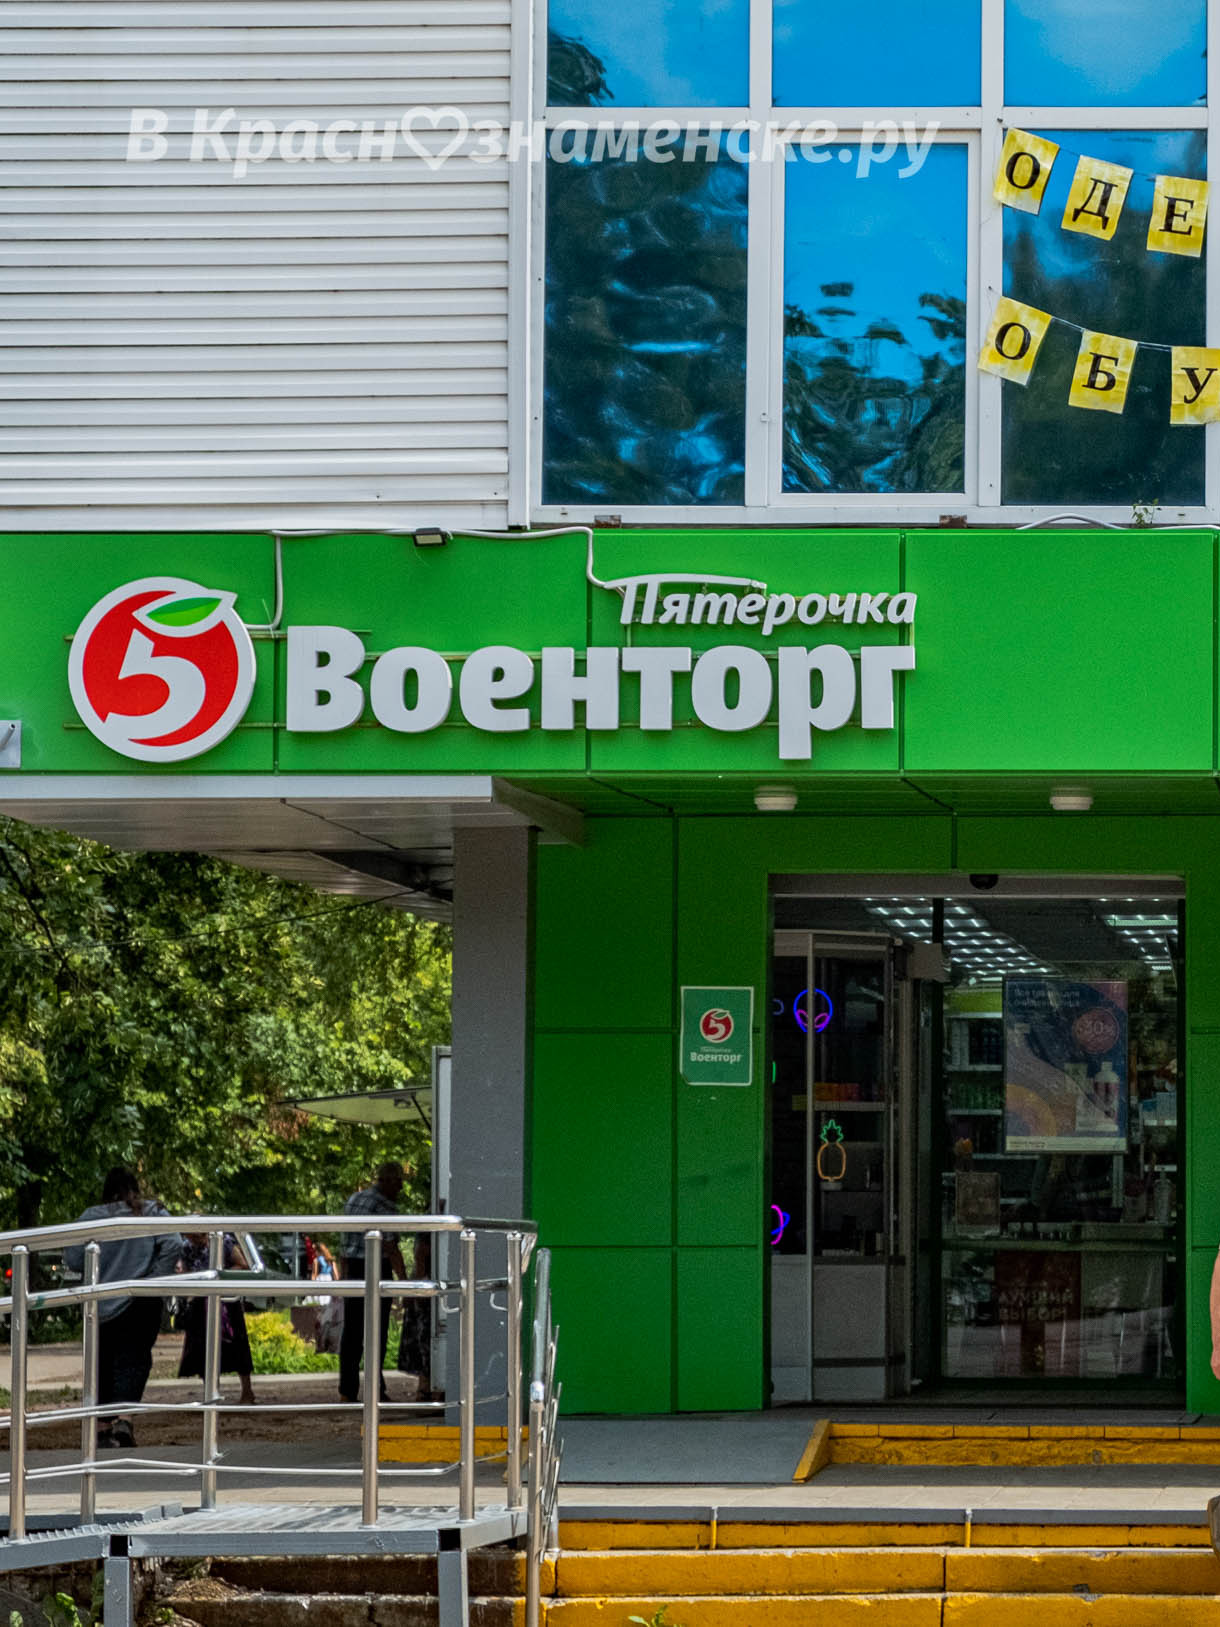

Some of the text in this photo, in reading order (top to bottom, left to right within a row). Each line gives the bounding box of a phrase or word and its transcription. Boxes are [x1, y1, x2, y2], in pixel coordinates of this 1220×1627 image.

[603, 573, 918, 636] Пятерочка
[286, 625, 917, 760] Военторг
[690, 1051, 743, 1065] Военторг
